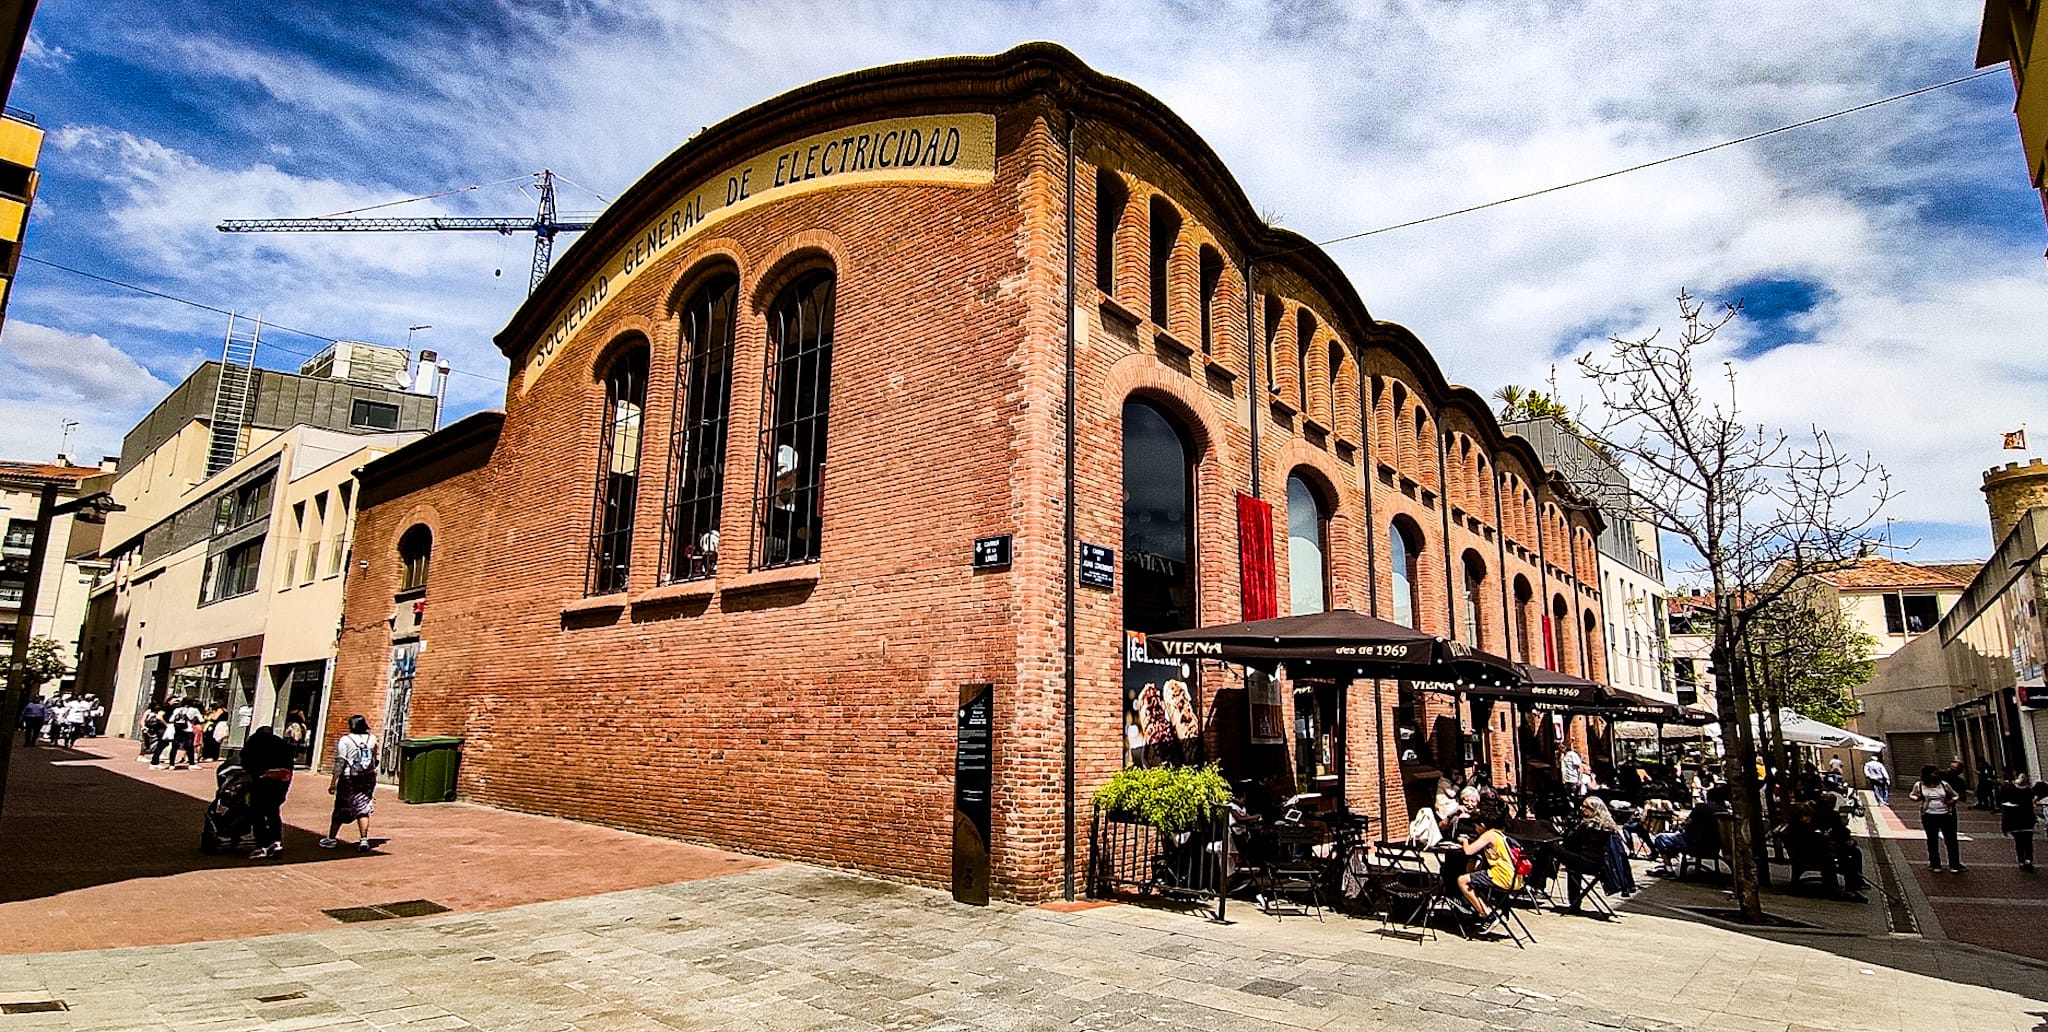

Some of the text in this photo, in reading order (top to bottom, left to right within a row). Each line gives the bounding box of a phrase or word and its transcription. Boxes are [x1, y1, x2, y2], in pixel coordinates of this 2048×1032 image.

[537, 127, 960, 367] SOCIEDAD GENERAL DE ELECTRICIDAD
[1162, 640, 1223, 655] VIENA
[1335, 645, 1408, 657] des de 1969
[1411, 680, 1455, 691] VIENA
[1531, 686, 1580, 697] des de 1969
